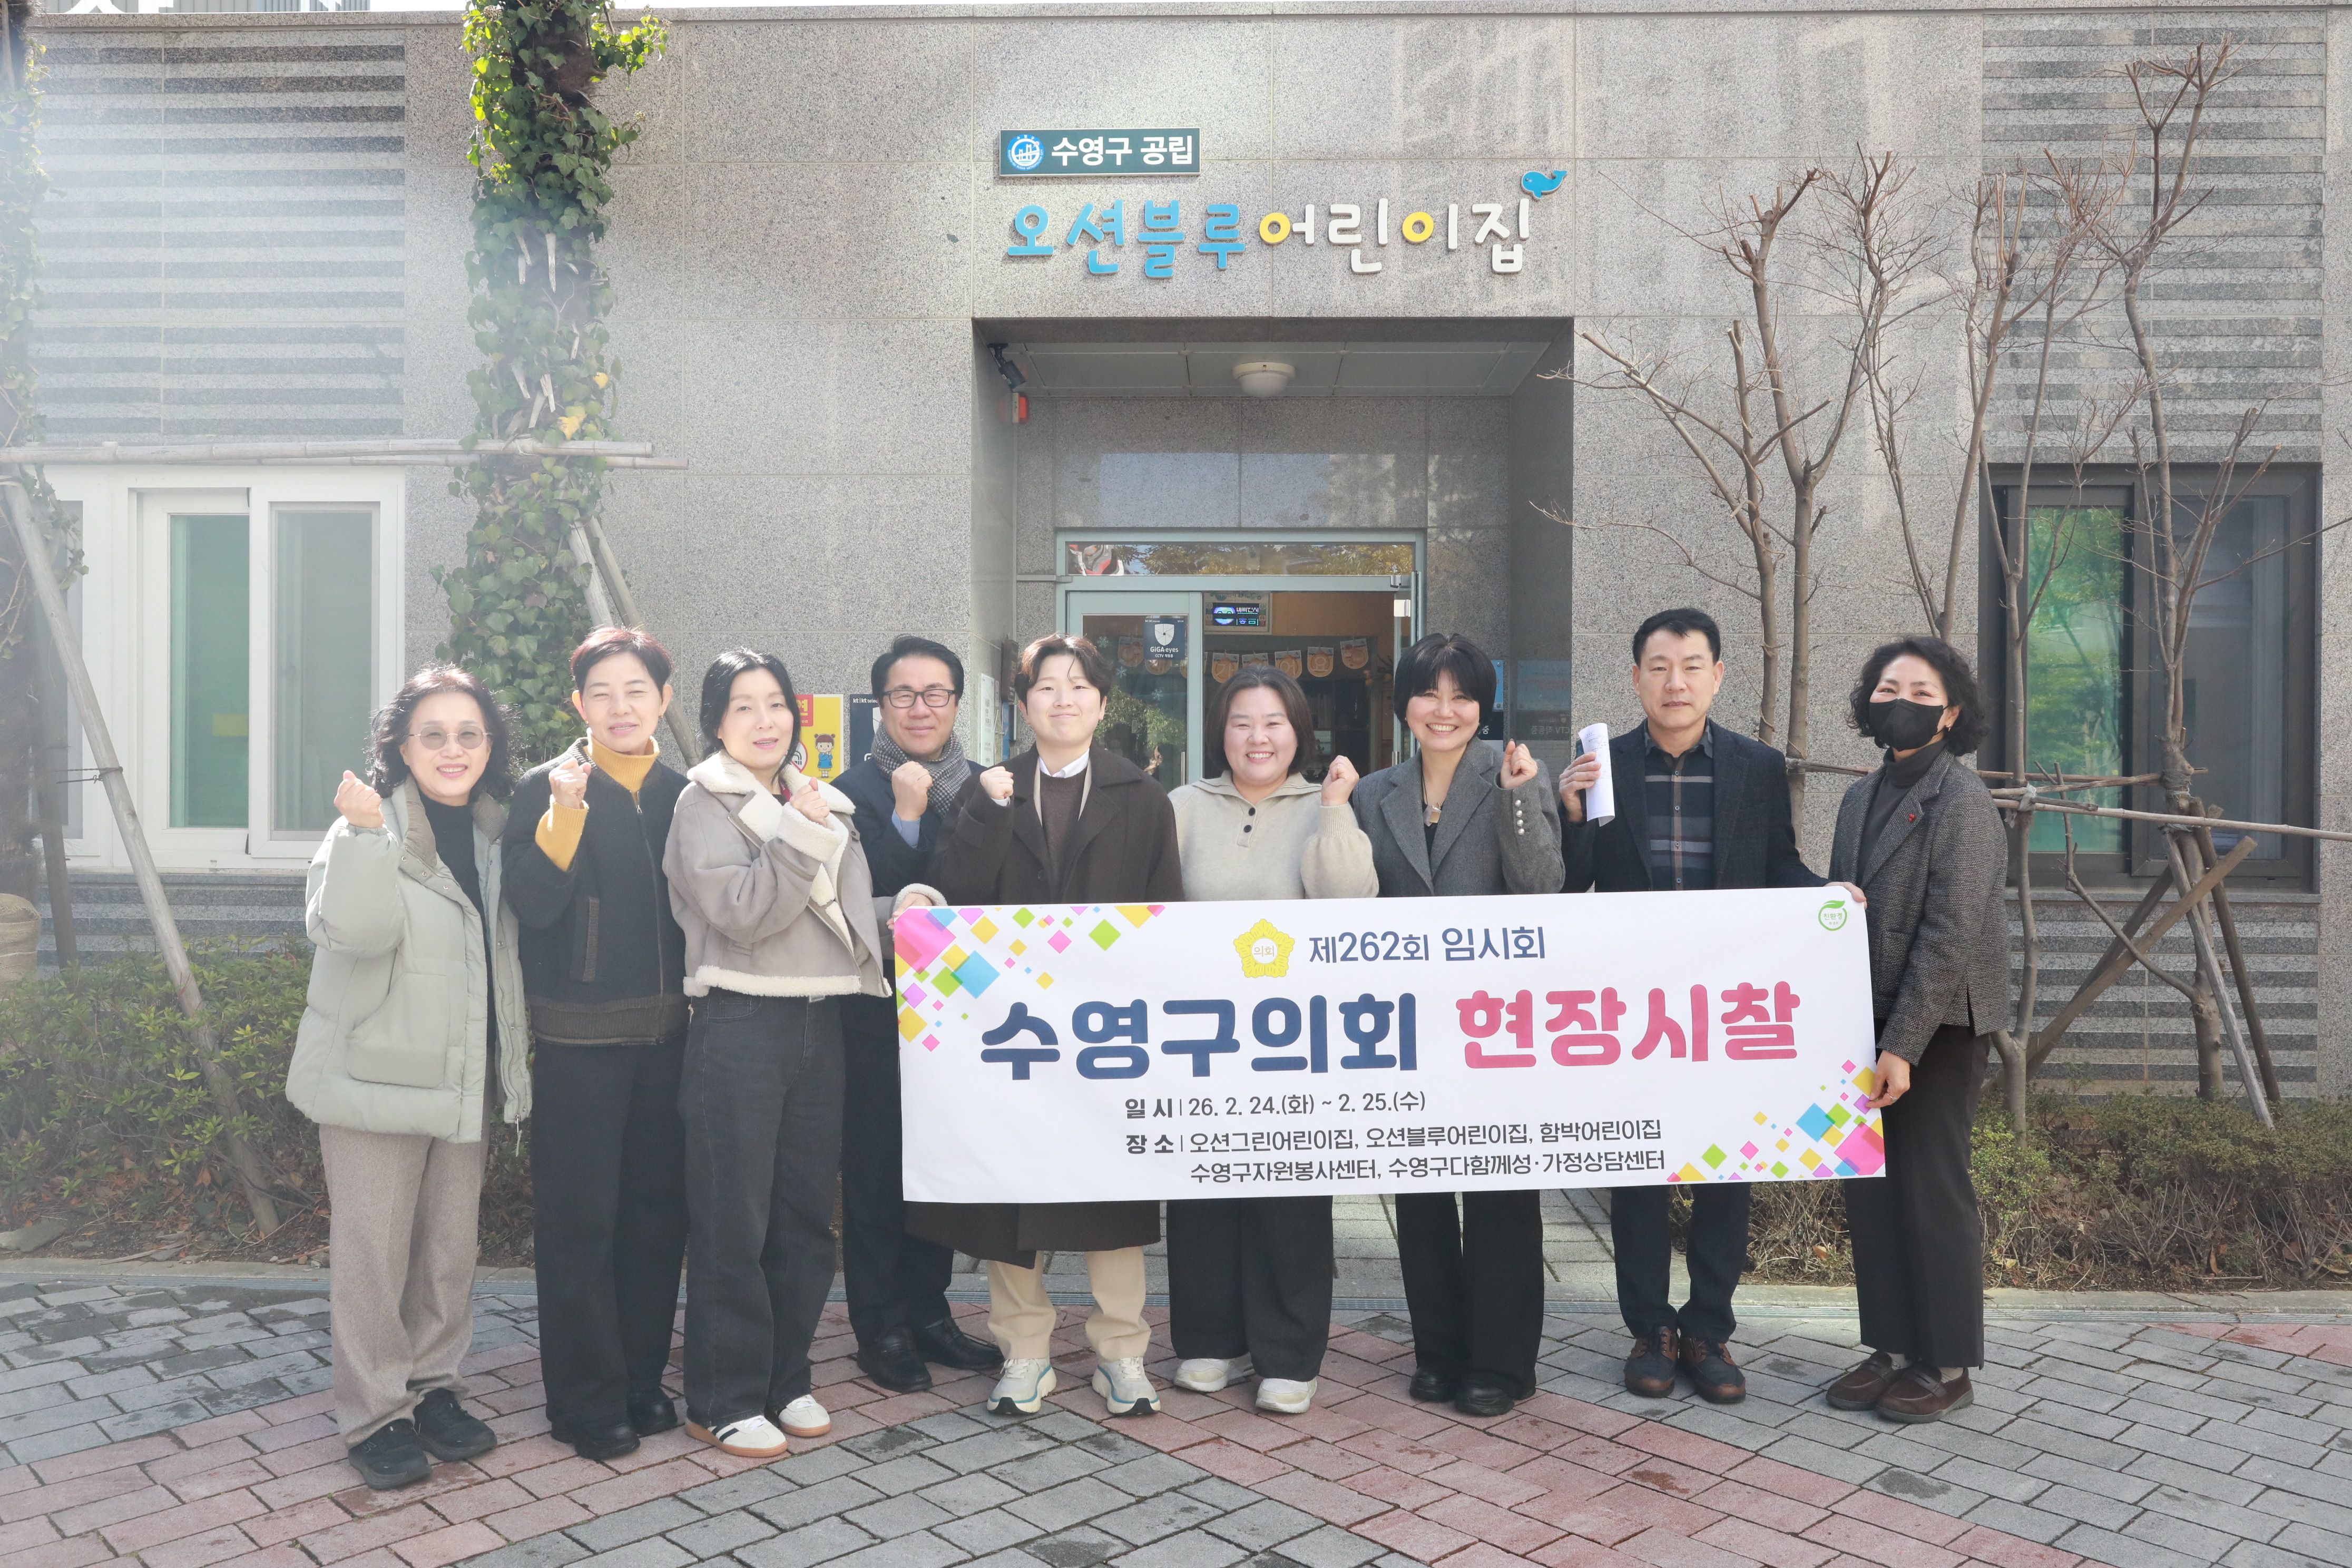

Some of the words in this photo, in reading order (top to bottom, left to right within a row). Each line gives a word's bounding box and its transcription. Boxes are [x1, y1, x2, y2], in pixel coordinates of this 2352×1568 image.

[1052, 136, 1132, 166] 수영구
[1140, 135, 1192, 165] 공립
[1008, 198, 1529, 279] 오션블루어린이집
[1253, 945, 1275, 957] 의회
[1309, 931, 1429, 963] 제262회
[1442, 926, 1545, 962] 임시회
[981, 993, 1417, 1081] 수영구의회
[1455, 981, 1800, 1069] 현장시찰
[1189, 1097, 1218, 1116] 26.
[1225, 1097, 1242, 1115] 2.
[1249, 1094, 1314, 1115] 24.(화)
[1338, 1093, 1355, 1112] 2.
[1363, 1091, 1425, 1112] 25.(수)
[1190, 1129, 1358, 1153] 오션그린어린이집,
[1366, 1124, 1533, 1148] 오션블루어린이집,
[1540, 1119, 1661, 1143] 함박어린이집
[1191, 1159, 1381, 1183] 수영구자원봉사센터,
